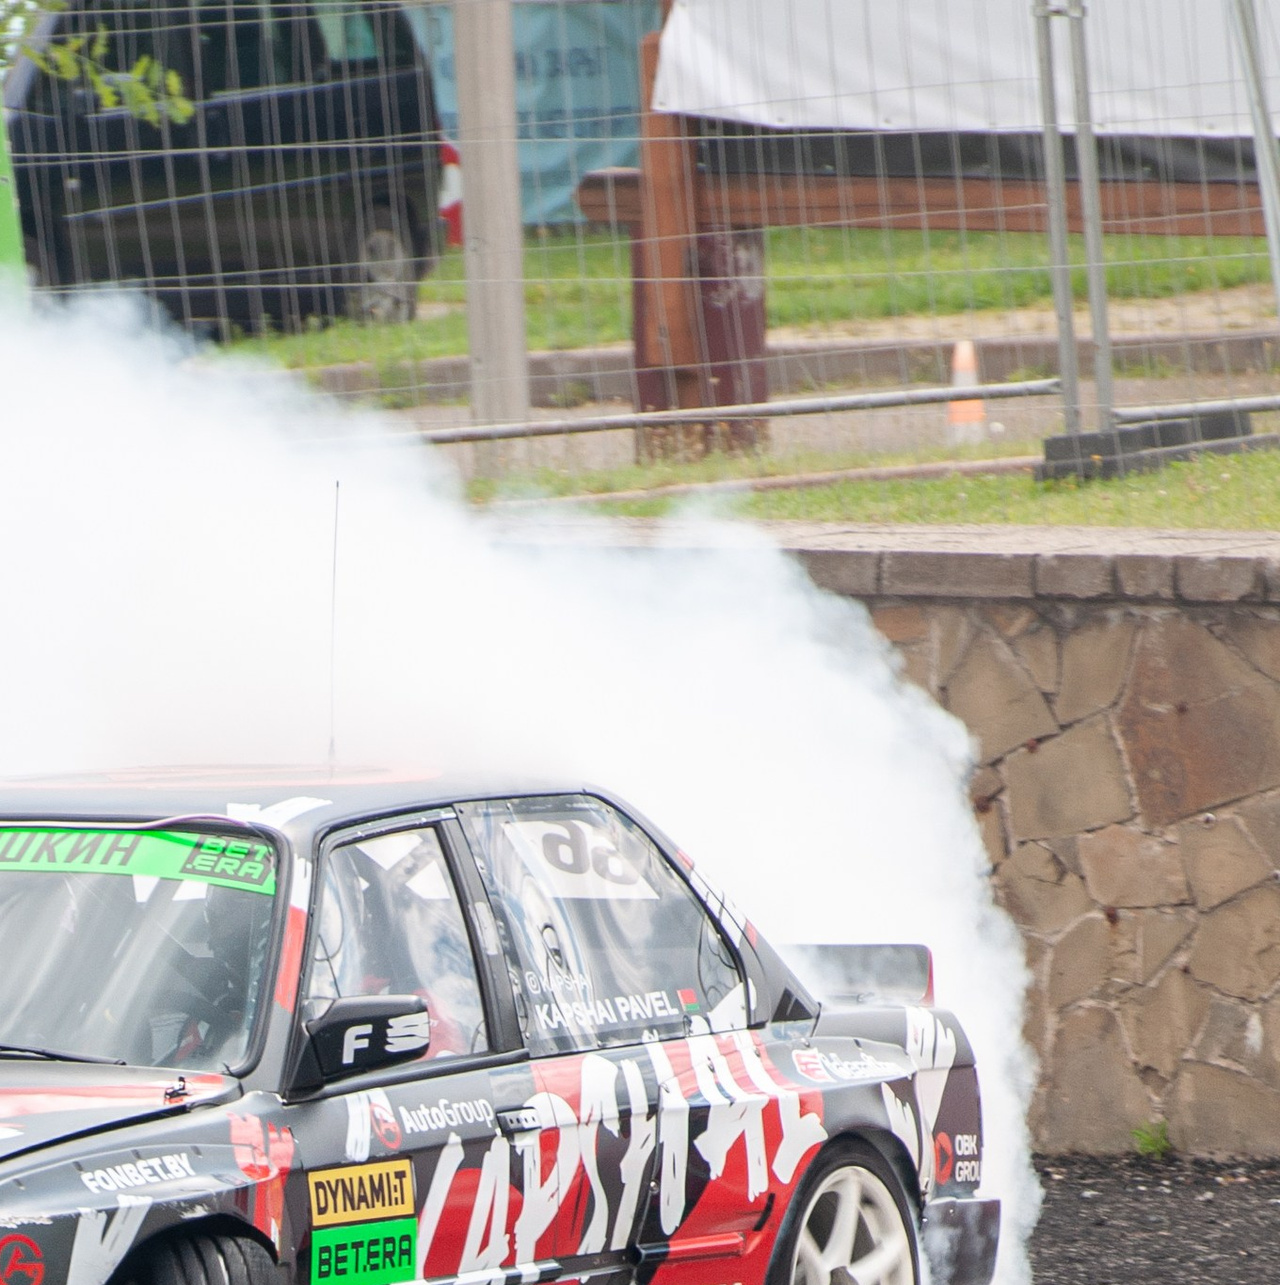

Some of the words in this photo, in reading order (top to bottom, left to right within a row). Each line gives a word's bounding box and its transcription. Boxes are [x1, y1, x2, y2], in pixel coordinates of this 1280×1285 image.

[535, 998, 618, 1030] KAPSHAI
[614, 991, 680, 1021] PAVEL
[399, 1099, 494, 1134] AutoGroup
[80, 1153, 197, 1194] FONBET.BY
